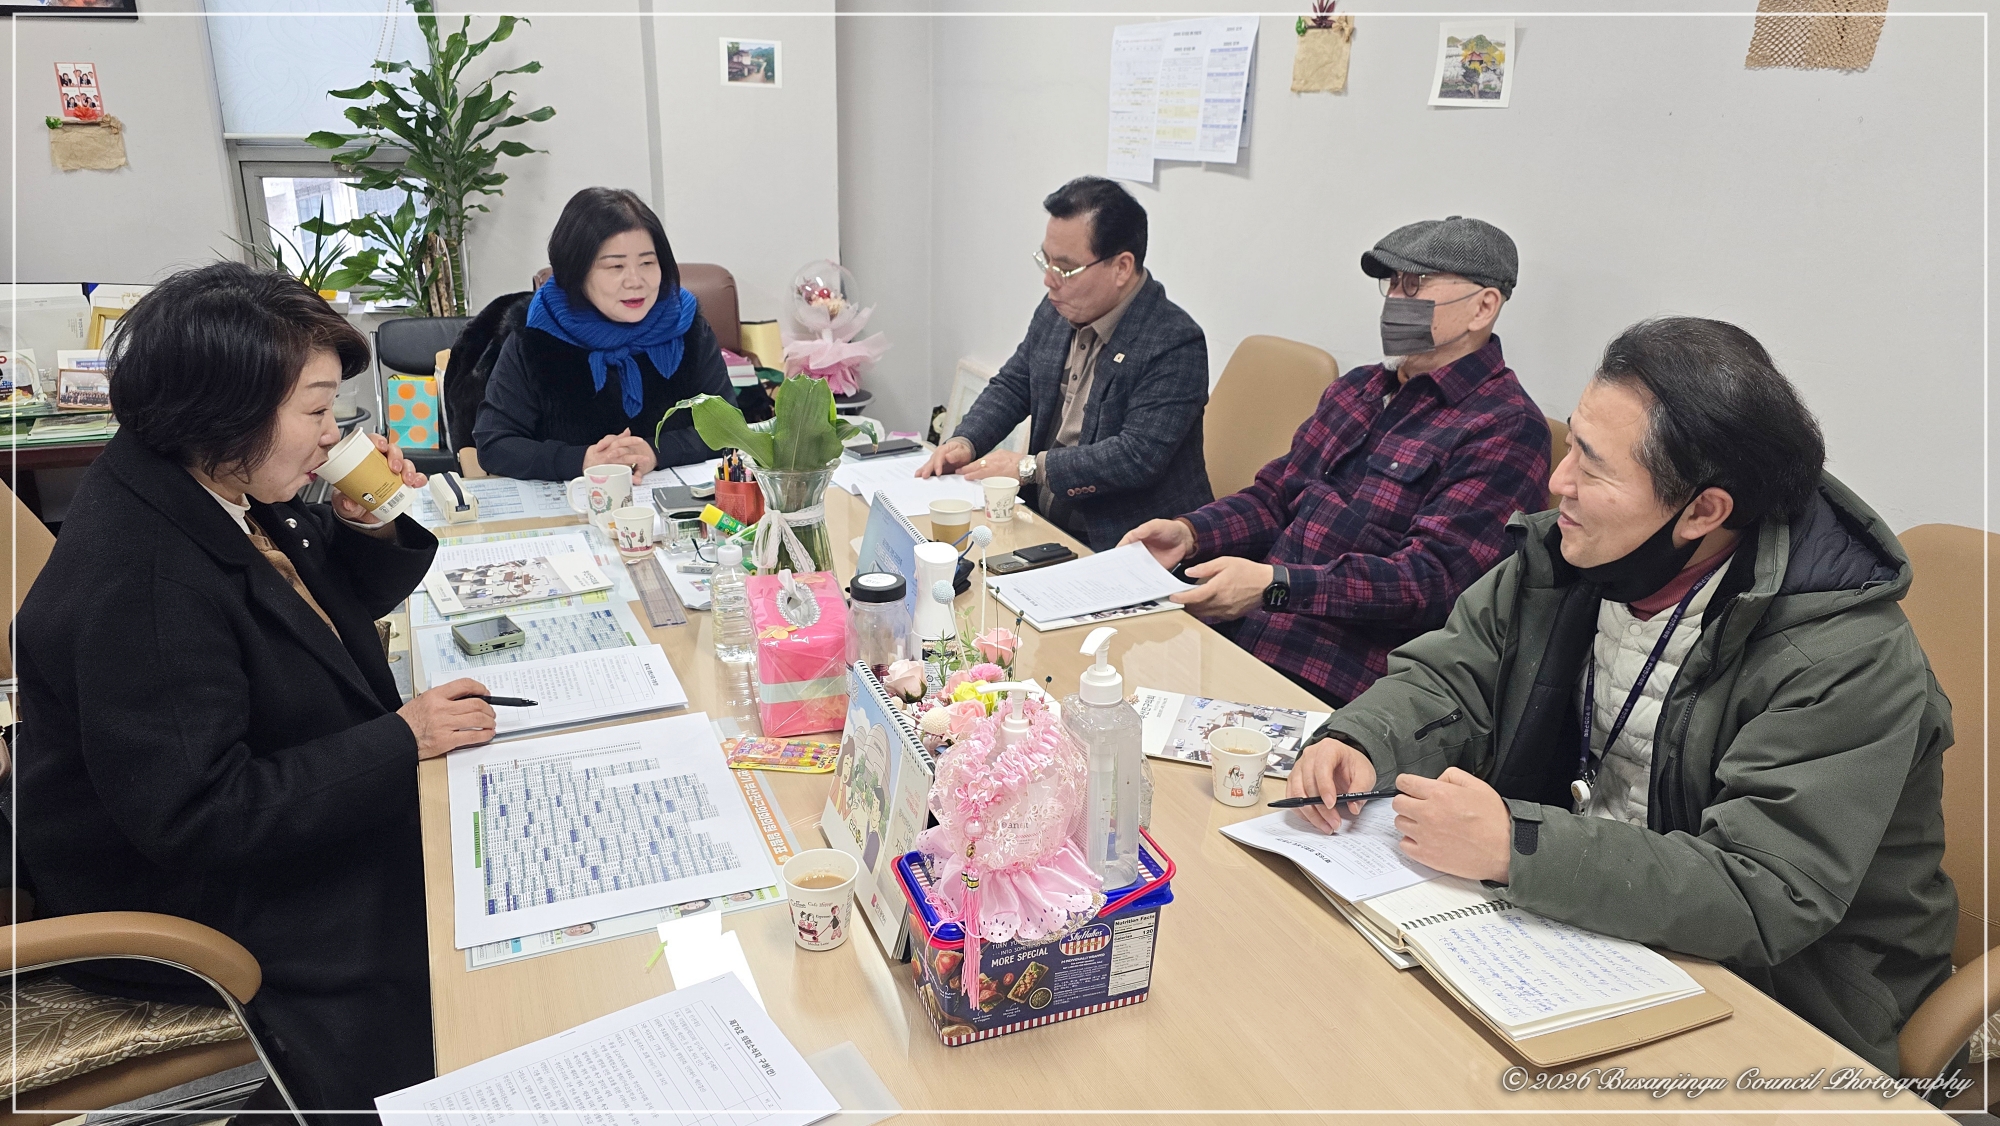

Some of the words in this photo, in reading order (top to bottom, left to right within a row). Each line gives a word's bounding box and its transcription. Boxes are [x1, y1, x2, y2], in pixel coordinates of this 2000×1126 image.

[1115, 918, 1138, 926] Nutrition
[992, 941, 1007, 950] TURN
[991, 957, 1015, 967] MORE
[1017, 948, 1048, 961] SPECIAL
[729, 1019, 744, 1035] 제76호
[740, 1035, 762, 1057] 의회소식지
[758, 1058, 776, 1076] 구성(안)
